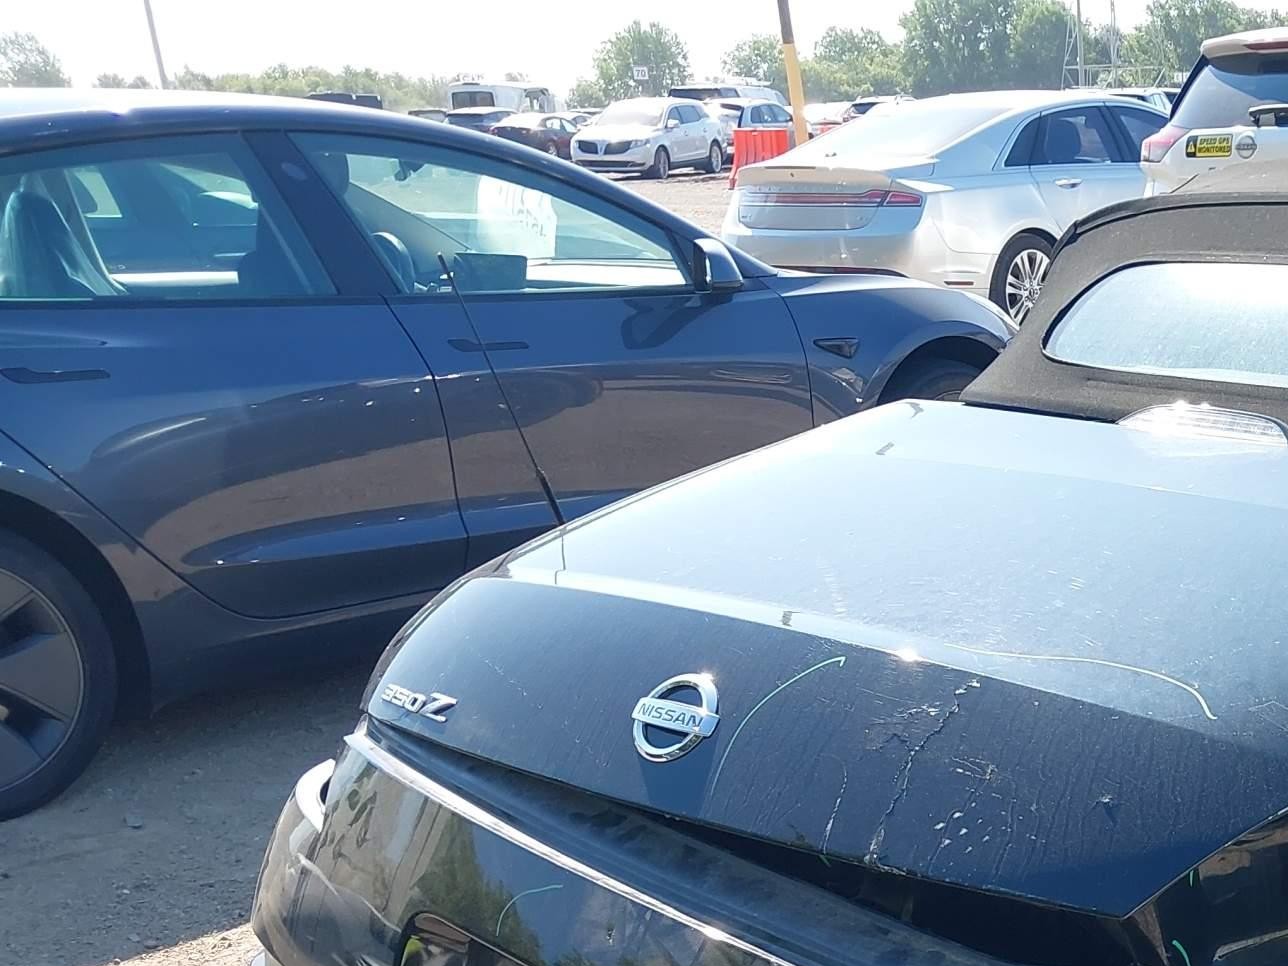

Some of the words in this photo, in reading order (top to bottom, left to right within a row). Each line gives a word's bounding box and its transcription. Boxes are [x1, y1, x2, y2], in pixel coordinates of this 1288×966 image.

[635, 69, 646, 78] 70
[1199, 136, 1217, 145] SPEED
[1218, 136, 1230, 144] GPS
[1198, 145, 1230, 154] MONITORED
[381, 683, 458, 723] 350Z
[636, 700, 704, 734] NISSAN
